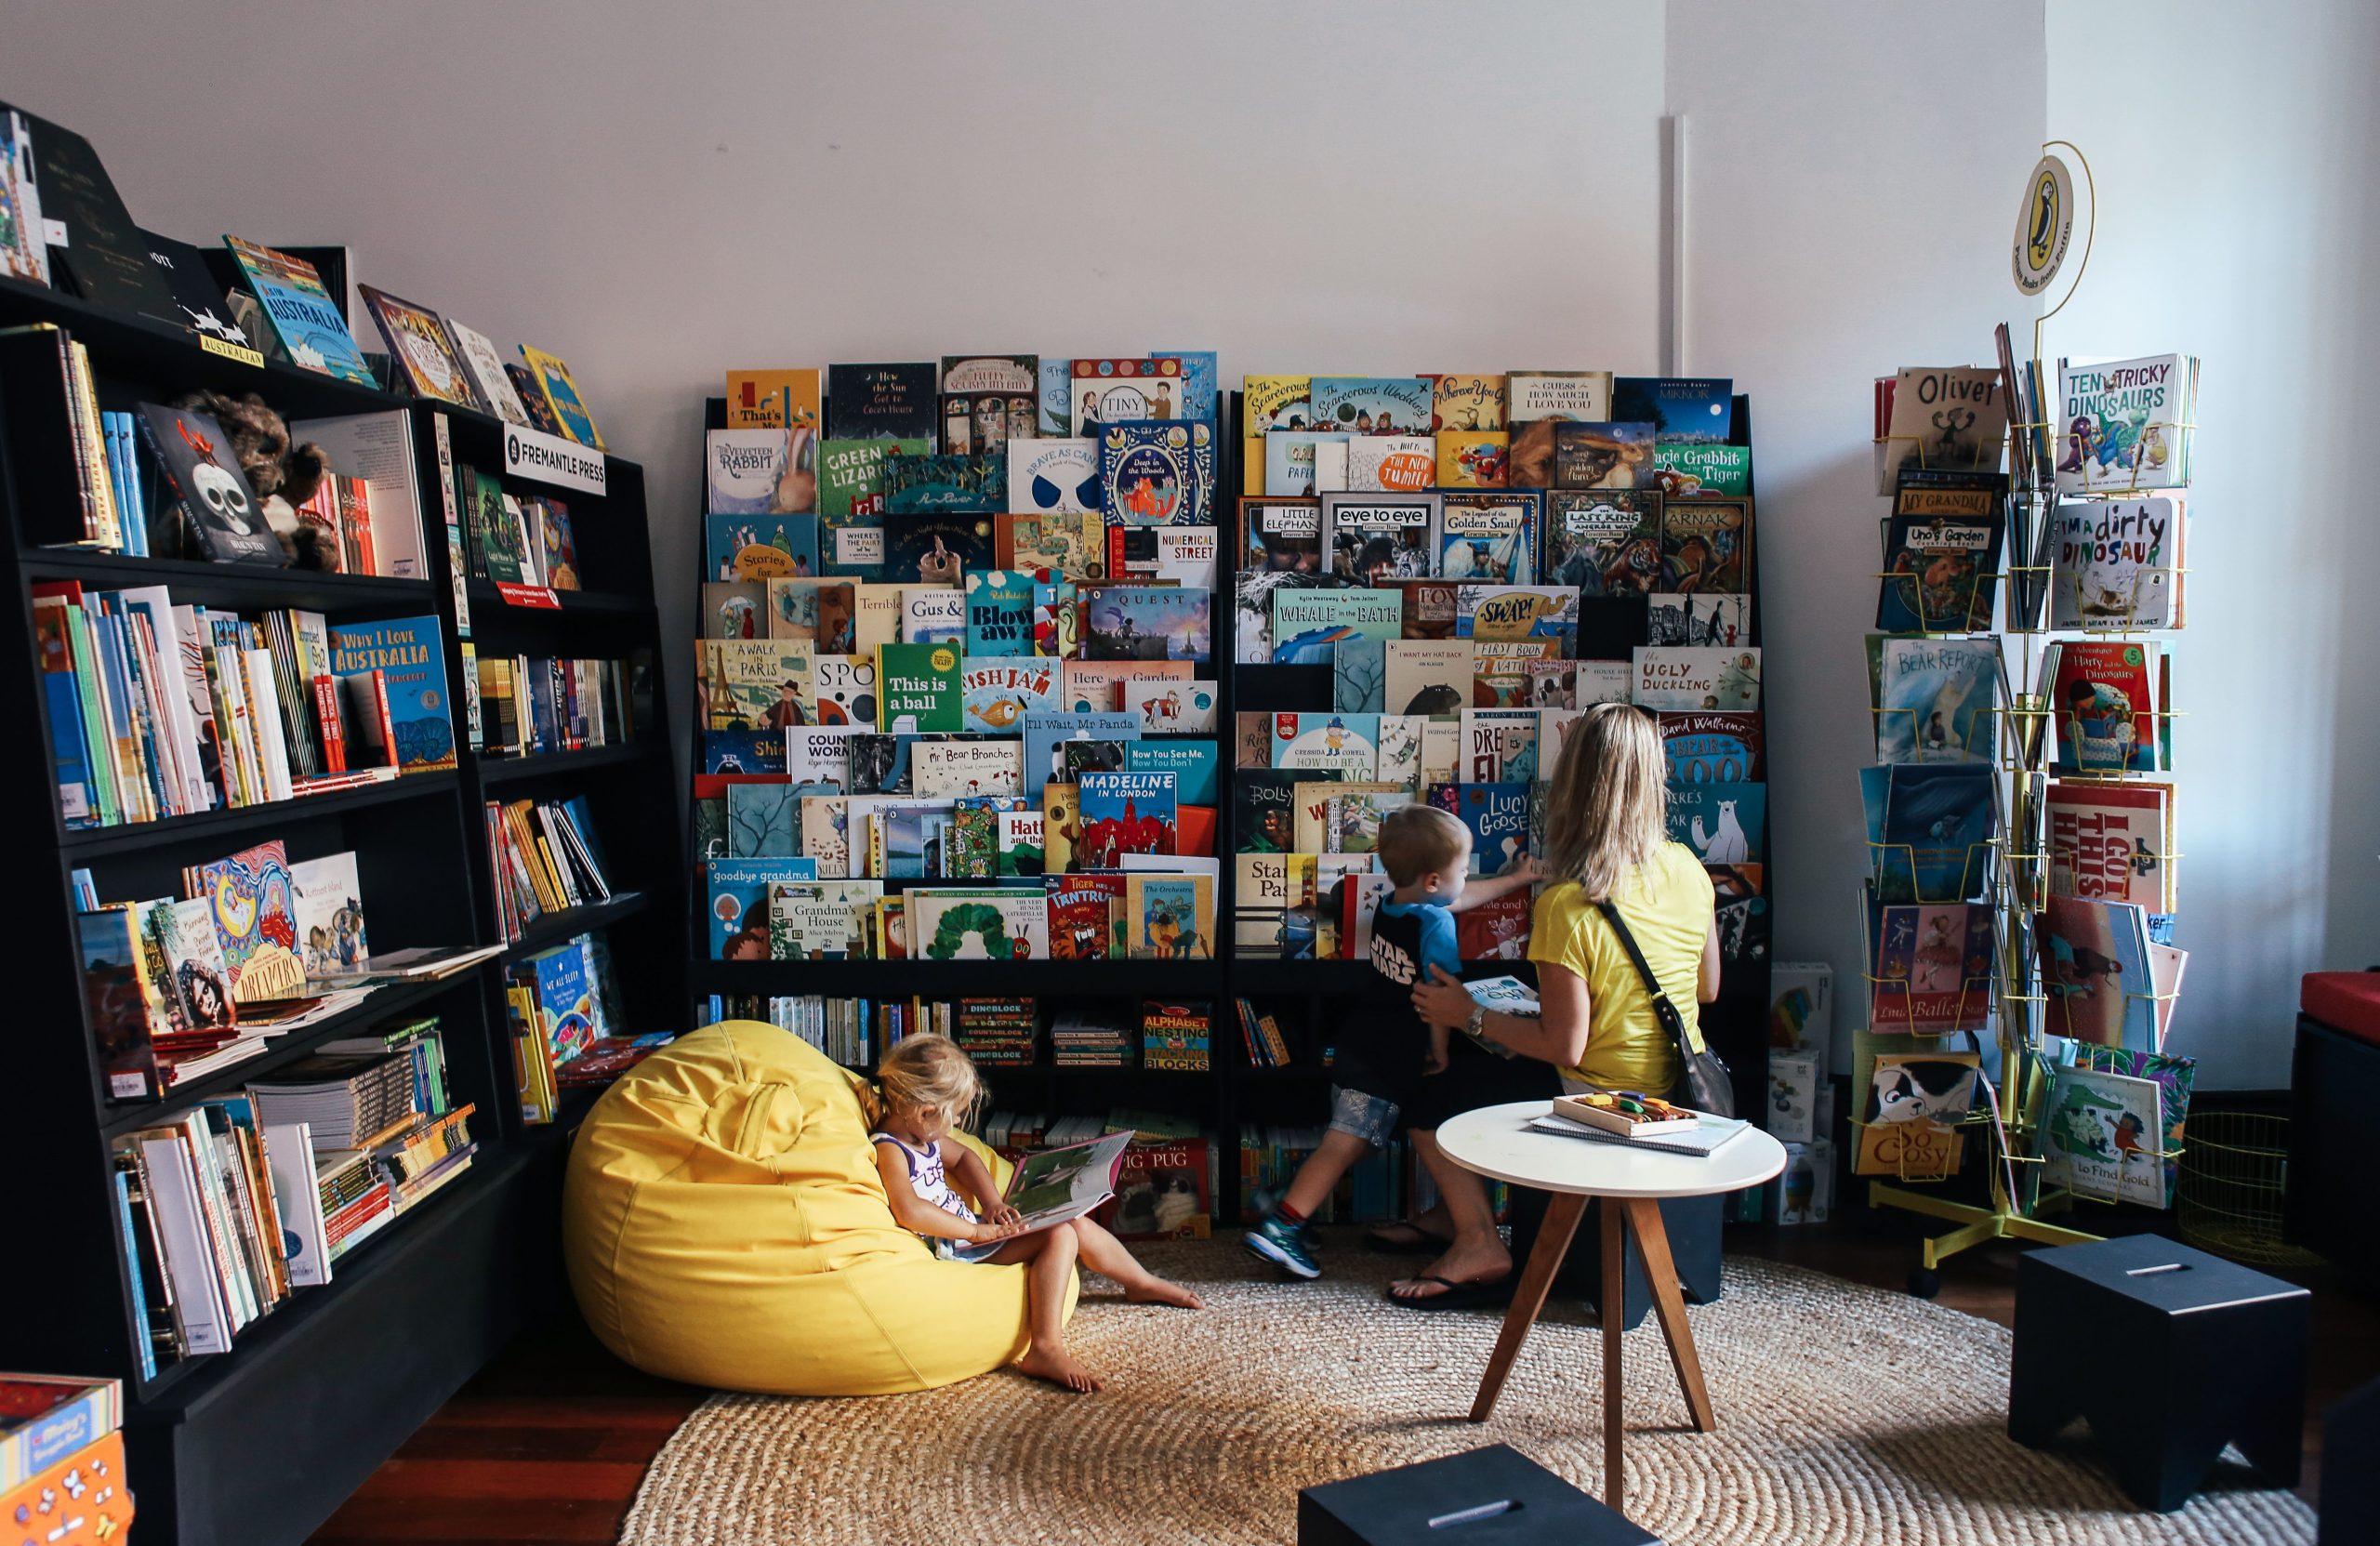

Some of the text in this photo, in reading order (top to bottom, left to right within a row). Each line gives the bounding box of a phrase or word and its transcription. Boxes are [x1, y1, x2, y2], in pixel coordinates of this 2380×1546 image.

[267, 297, 348, 337] AUSTRALIA
[205, 339, 262, 363] AUSTRALIAN
[1542, 382, 1576, 390] GUESS
[2068, 363, 2170, 395] TEN TRICKY
[1528, 391, 1590, 400] HOW MUCH
[1659, 390, 1710, 400] MIRROR
[1918, 374, 1999, 406] Oliver
[1104, 397, 1143, 412] TINY
[1526, 401, 1592, 409] I LOVE YOU
[2068, 387, 2165, 418] DINOSAURS
[741, 409, 782, 421] That's
[522, 443, 604, 482] FREMANTLE PRESS
[827, 446, 882, 471] GREEN
[1025, 448, 1096, 476] BRAVE AS CAN
[1133, 458, 1160, 468] Deep in
[1390, 456, 1429, 470] THE NEW
[1684, 450, 1740, 466] Grabbit
[1384, 468, 1428, 487] JUMPER
[1903, 494, 1987, 513] MY GRANDMA
[1282, 509, 1316, 519] LITTLE
[1341, 509, 1423, 523] eye to eye
[1569, 512, 1640, 522] LAST KING
[1448, 517, 1518, 528] Golden Snail
[2083, 519, 2093, 534] A
[2095, 505, 2166, 549] dirty
[1162, 535, 1214, 546] NUMERICAL
[1911, 528, 1985, 542] Uno's Garden
[1174, 547, 1214, 559] STREET
[2062, 539, 2161, 567] DINOSAUR
[744, 554, 786, 567] Stories
[758, 567, 773, 576] for
[860, 598, 901, 610] Terrible
[1118, 594, 1186, 605] QUEST
[911, 601, 963, 616] Gus &
[1280, 605, 1336, 622] WHALE
[1357, 605, 1399, 622] BATH
[1480, 598, 1534, 623] SWAP!
[342, 630, 415, 649] WHY I LOVE
[737, 644, 775, 656] A WALK
[1481, 643, 1541, 656] FIRST BOOK
[2075, 646, 2113, 654] Adventures
[336, 645, 430, 672] AUSTRALIA
[1897, 648, 1986, 675] BEAR REPORT
[2073, 655, 2103, 669] Harry
[740, 662, 777, 677] PARIS
[1643, 663, 1691, 678] UGLY
[2085, 669, 2134, 681] Dinosaurs
[889, 678, 946, 692] This is
[1642, 678, 1712, 691] DUCKLING
[890, 695, 936, 710] a ball
[1027, 719, 1135, 731] I'll Wait, Mr Panda
[1661, 717, 1745, 736] David Walliams
[1674, 738, 1721, 757] BEAR
[930, 747, 1013, 764] Mr Bear Branches
[1132, 750, 1205, 760] Now You See Me,
[1132, 759, 1192, 767] Now You Don't
[1297, 759, 1365, 767] HOW TO BE A
[1080, 774, 1173, 789] MADELINE
[1098, 789, 1157, 798] IN LONDON
[1490, 792, 1529, 817] LUCY
[1480, 815, 1529, 836] GOOSE
[1011, 836, 1043, 844] and the
[2078, 813, 2105, 898] THIS
[714, 871, 758, 883] goodbye
[760, 870, 810, 883] grandma
[2104, 838, 2130, 901] GOT
[1144, 885, 1193, 893] The Orchestra
[794, 904, 856, 917] Grandma's
[807, 916, 844, 927] House
[1371, 933, 1410, 965] STAR
[1370, 949, 1417, 986] WARS
[1911, 998, 1960, 1016] Ballet
[1144, 1017, 1208, 1028] ALPHABET
[1144, 1027, 1208, 1038] NESTING
[1144, 1050, 1208, 1060] STACKING
[1145, 1059, 1209, 1070] BLOCKS
[1873, 1137, 1950, 1167] Cosy
[2092, 1164, 2118, 1180] Find
[2122, 1170, 2149, 1187] Gold
